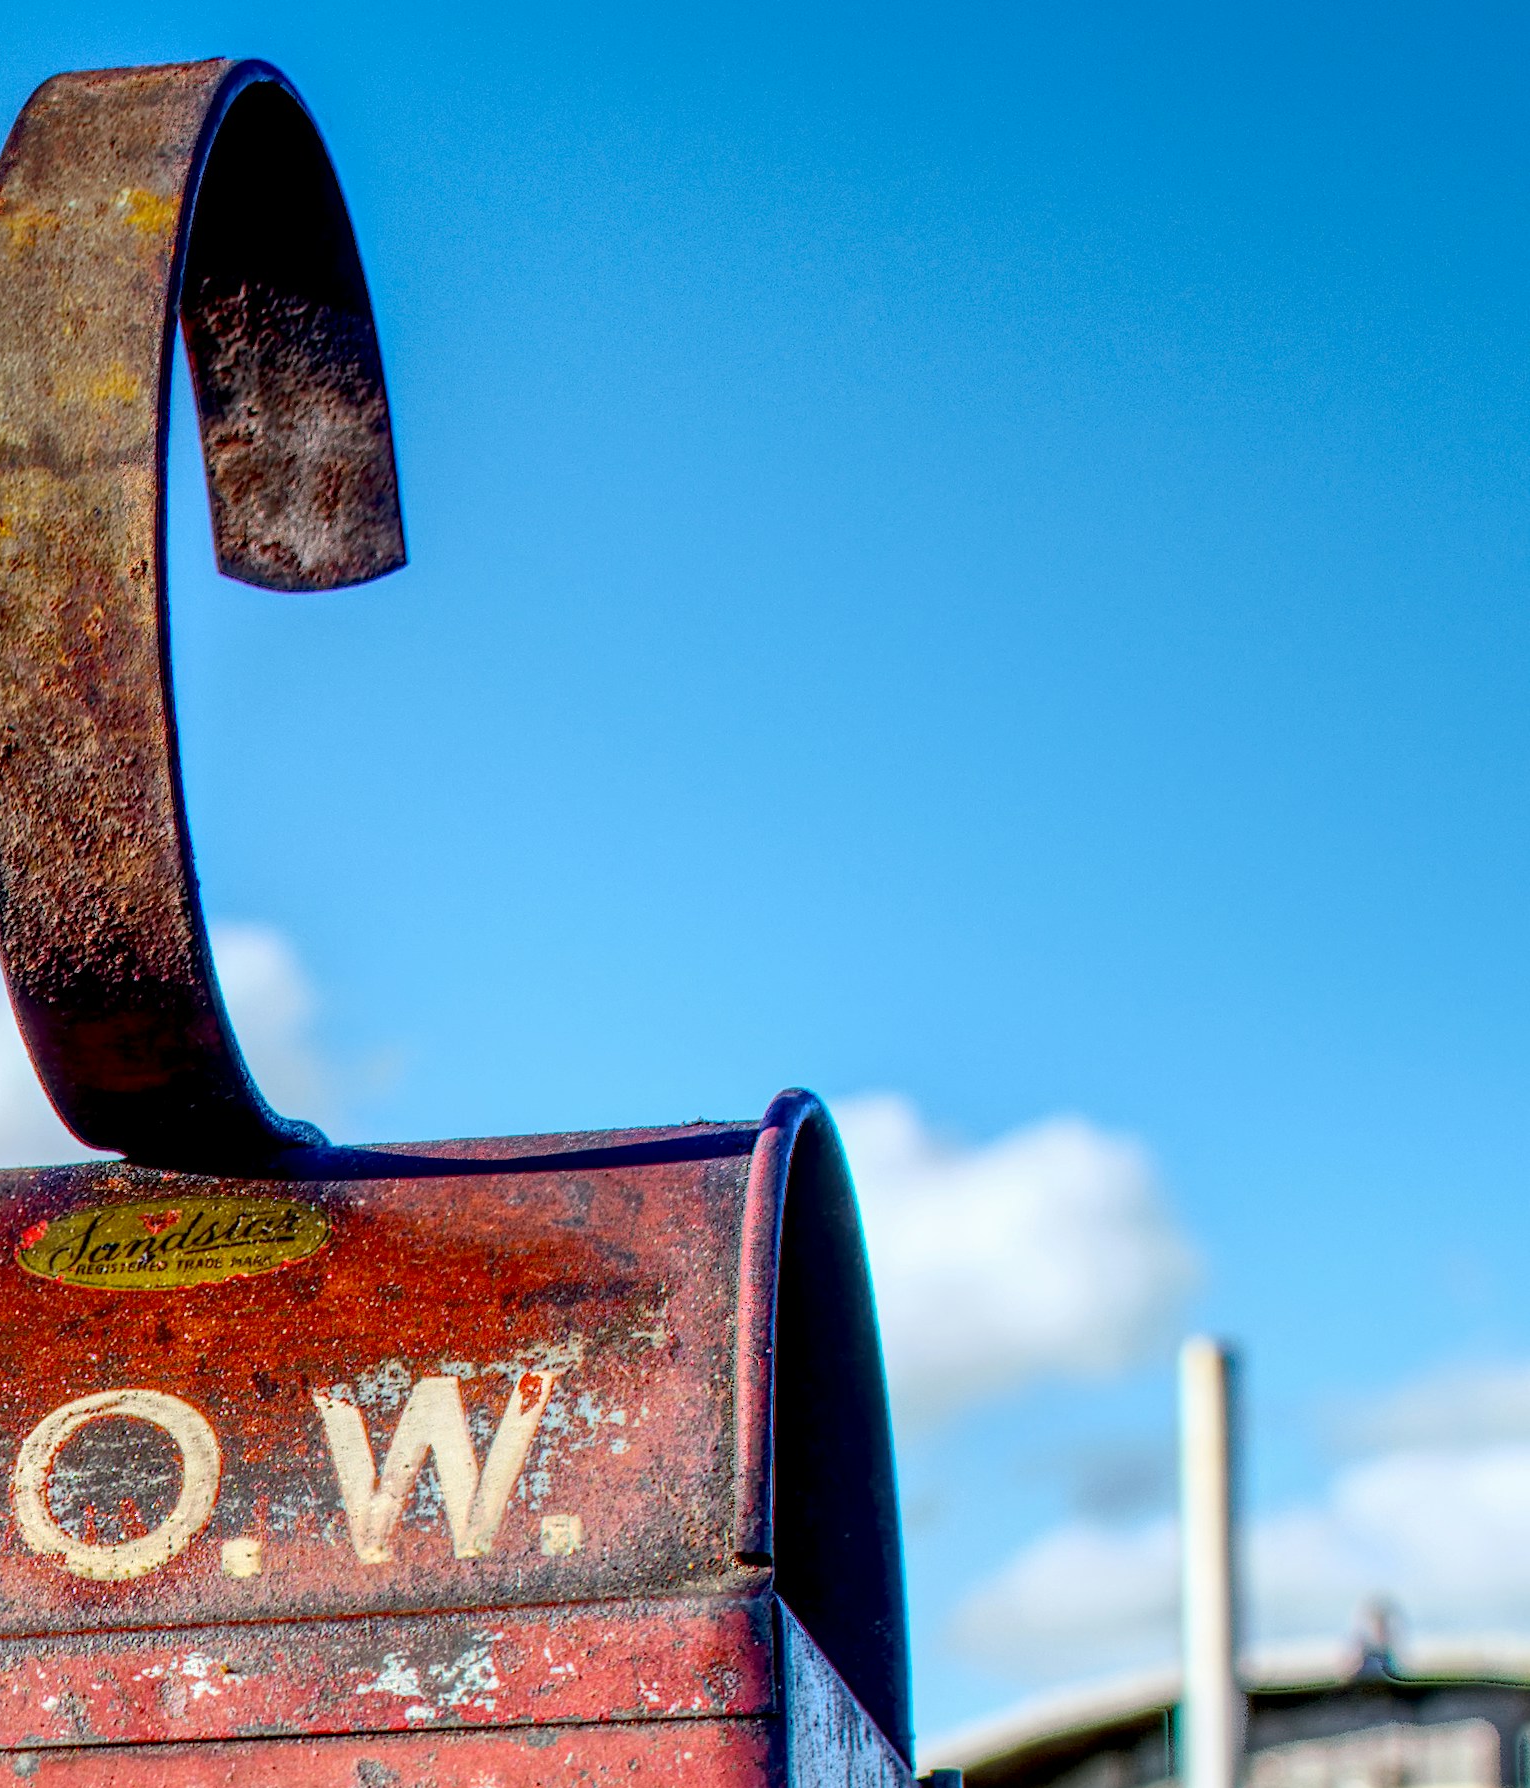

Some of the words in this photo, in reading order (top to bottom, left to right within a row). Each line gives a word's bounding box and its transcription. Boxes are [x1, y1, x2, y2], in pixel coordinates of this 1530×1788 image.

[75, 1257, 168, 1276] REGISTERED
[176, 1256, 223, 1272] TRADE
[230, 1254, 273, 1269] MARK
